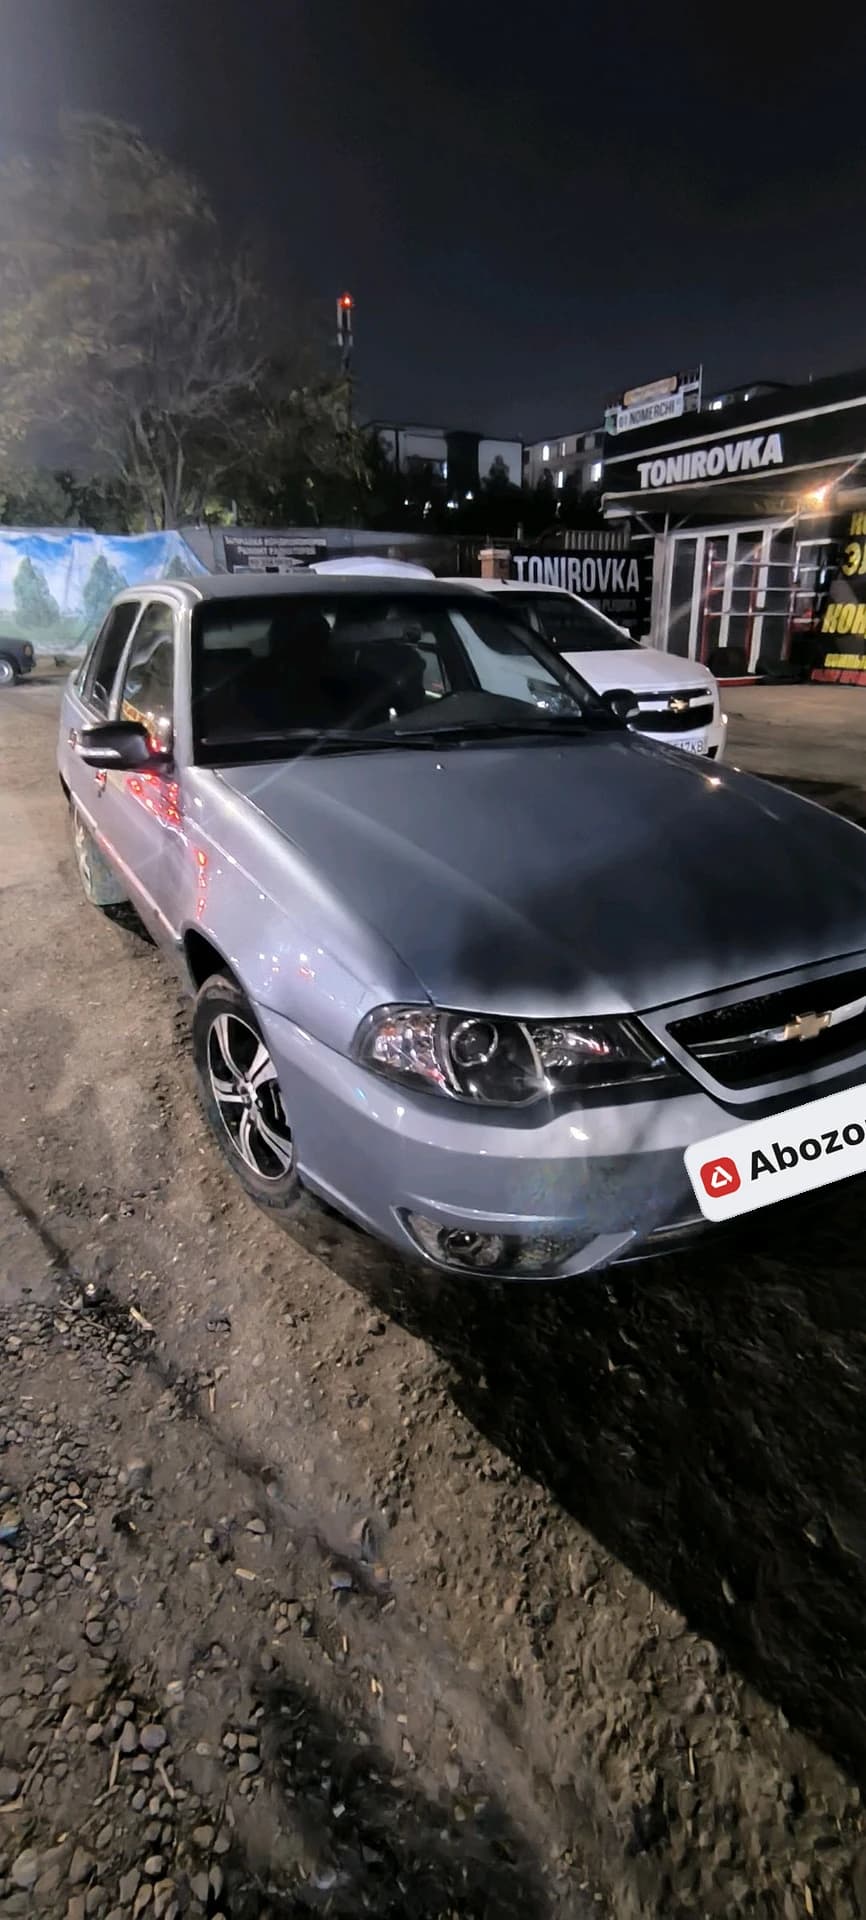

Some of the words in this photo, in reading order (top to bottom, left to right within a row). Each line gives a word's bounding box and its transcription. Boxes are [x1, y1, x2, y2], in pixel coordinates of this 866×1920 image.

[629, 399, 675, 425] NOMERCHI
[637, 433, 783, 488] TONIROVKA
[513, 555, 640, 593] TONIROVKA
[841, 541, 866, 577] Э
